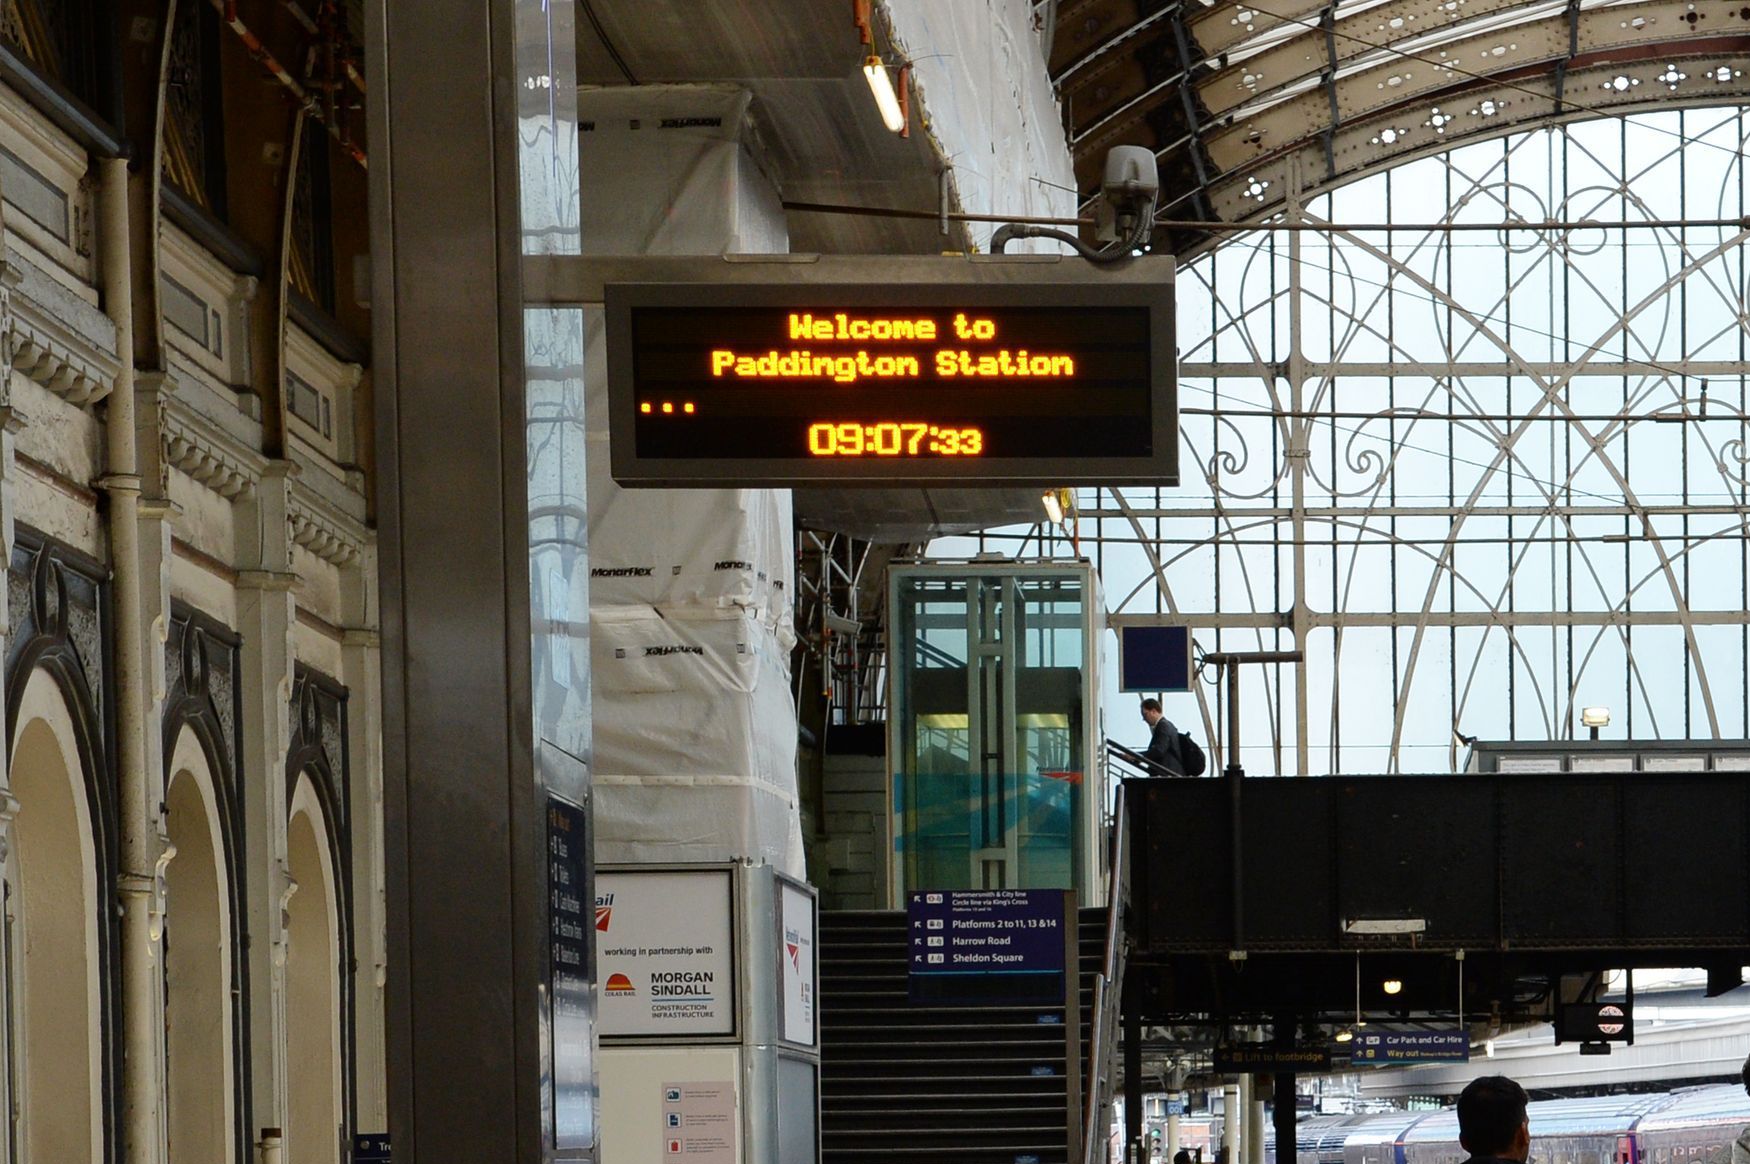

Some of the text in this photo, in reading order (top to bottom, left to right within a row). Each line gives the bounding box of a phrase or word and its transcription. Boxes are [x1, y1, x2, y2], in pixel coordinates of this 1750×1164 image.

[789, 313, 995, 341] Welcome to
[712, 350, 1074, 382] Paddington Station
[808, 421, 983, 456] 09:07:33
[591, 567, 653, 577] Monarflex
[645, 645, 704, 656] Monarflex
[952, 920, 995, 928] Platforms
[1015, 920, 1026, 928] 11,
[952, 936, 1011, 945] Harrow Road
[604, 946, 713, 957] working in partnership with
[953, 953, 1024, 963] Sheldon Square
[651, 972, 713, 983] MORGAN
[651, 985, 711, 996] SINDALL
[1386, 1036, 1397, 1044] Car
[1401, 1036, 1417, 1044] Park
[1433, 1035, 1446, 1043] Car
[1447, 1035, 1462, 1043] Hire
[1245, 1051, 1325, 1062] Lift to footbridge
[1386, 1049, 1404, 1058] Way
[1405, 1049, 1419, 1057] out
